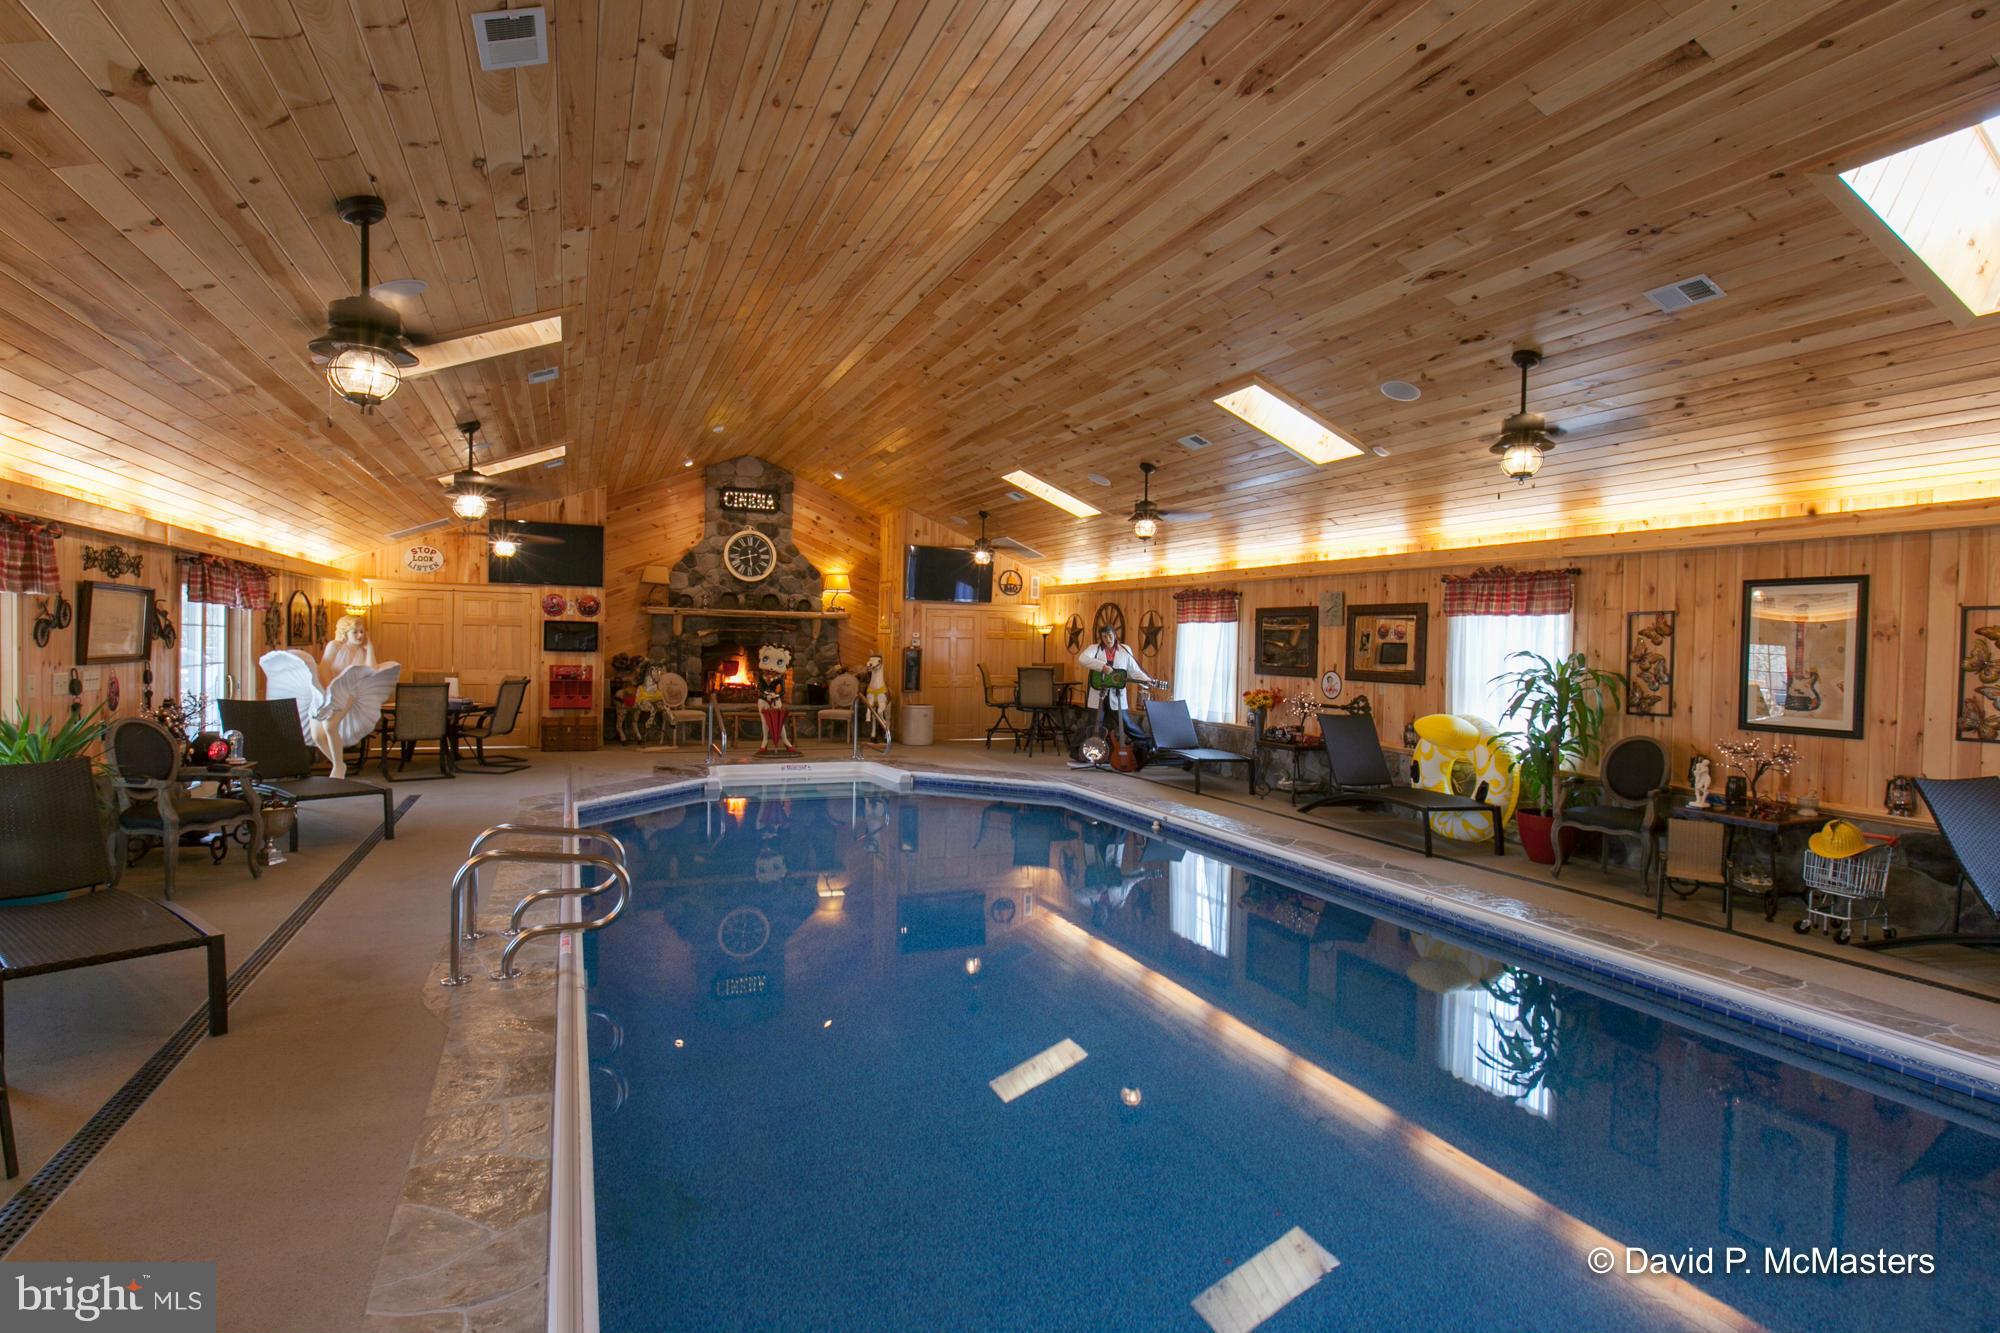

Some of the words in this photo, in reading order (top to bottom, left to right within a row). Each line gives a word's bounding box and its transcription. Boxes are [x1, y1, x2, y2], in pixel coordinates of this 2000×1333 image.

[723, 491, 775, 510] CINEMA
[410, 546, 437, 555] STOP
[408, 561, 439, 571] LISTEN
